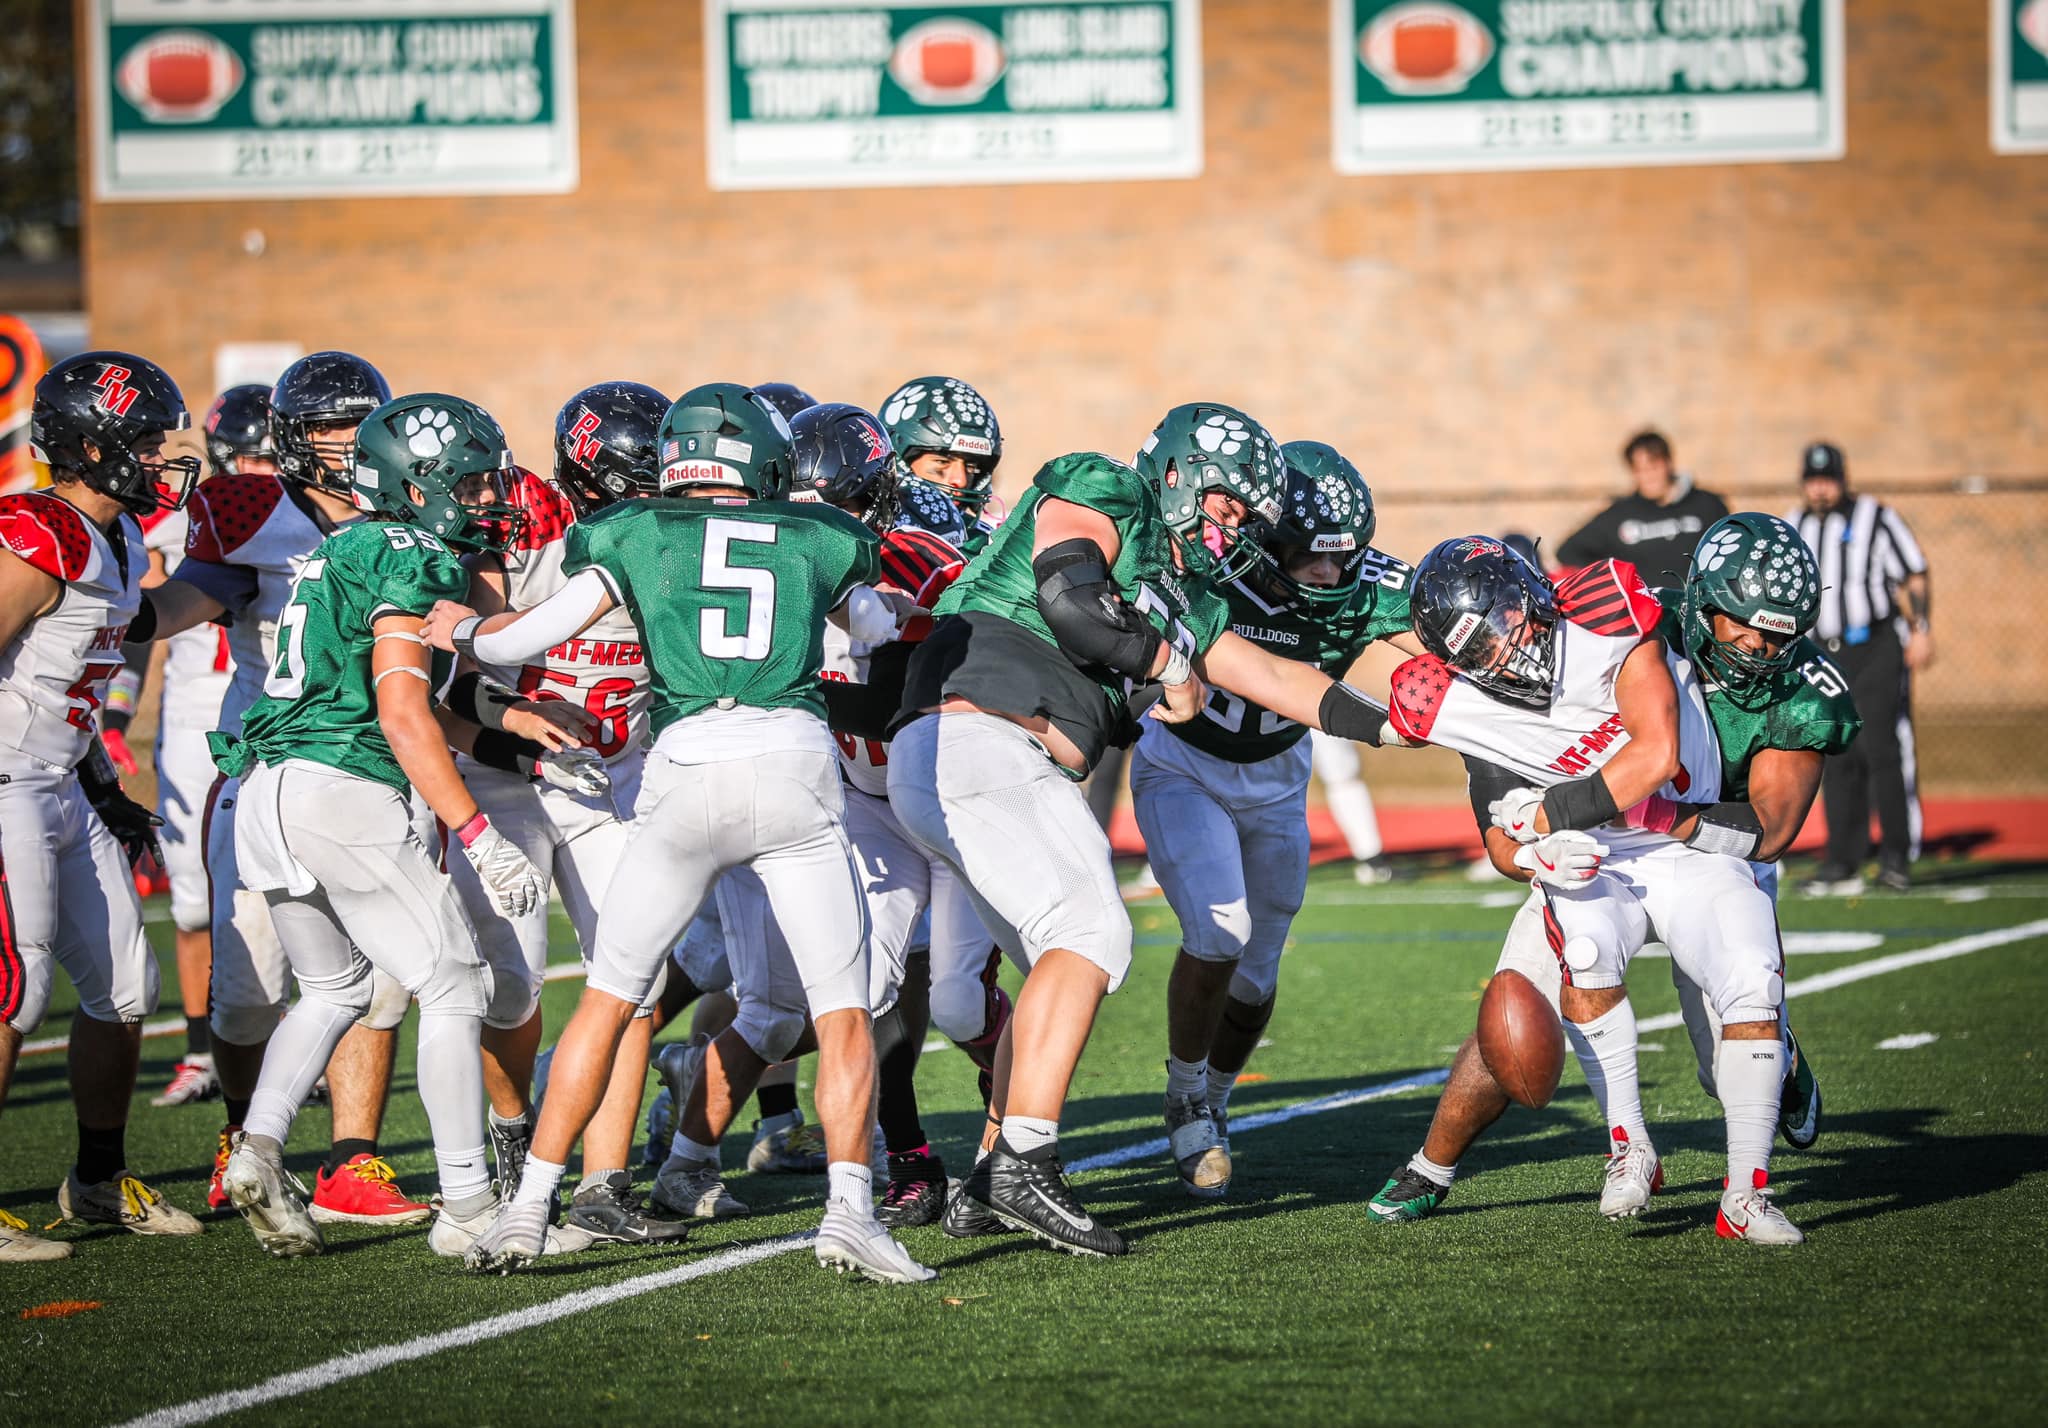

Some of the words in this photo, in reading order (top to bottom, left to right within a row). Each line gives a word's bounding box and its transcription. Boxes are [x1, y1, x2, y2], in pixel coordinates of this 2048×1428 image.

[1499, 0, 1657, 40] SUFFOLK
[1661, 0, 1803, 34] COUNTY
[250, 26, 399, 72] SUFFOLK
[403, 20, 540, 66] COUNTY
[734, 11, 893, 67] RUTGERS
[1005, 56, 1169, 111] CHAMPIONS
[1501, 37, 1809, 96] CHAMPIONS
[250, 66, 543, 126] CHAMPIONS
[746, 68, 883, 119] TROPHY
[958, 438, 990, 451] Riddell
[667, 464, 723, 483] Riddell
[383, 526, 446, 552] 55
[1317, 538, 1353, 549] Riddell
[699, 516, 778, 661] 5
[1231, 623, 1300, 646] BULLDOGS
[1449, 616, 1475, 650] Riddell
[1757, 614, 1796, 631] Riddell
[546, 638, 644, 666] AT-MED
